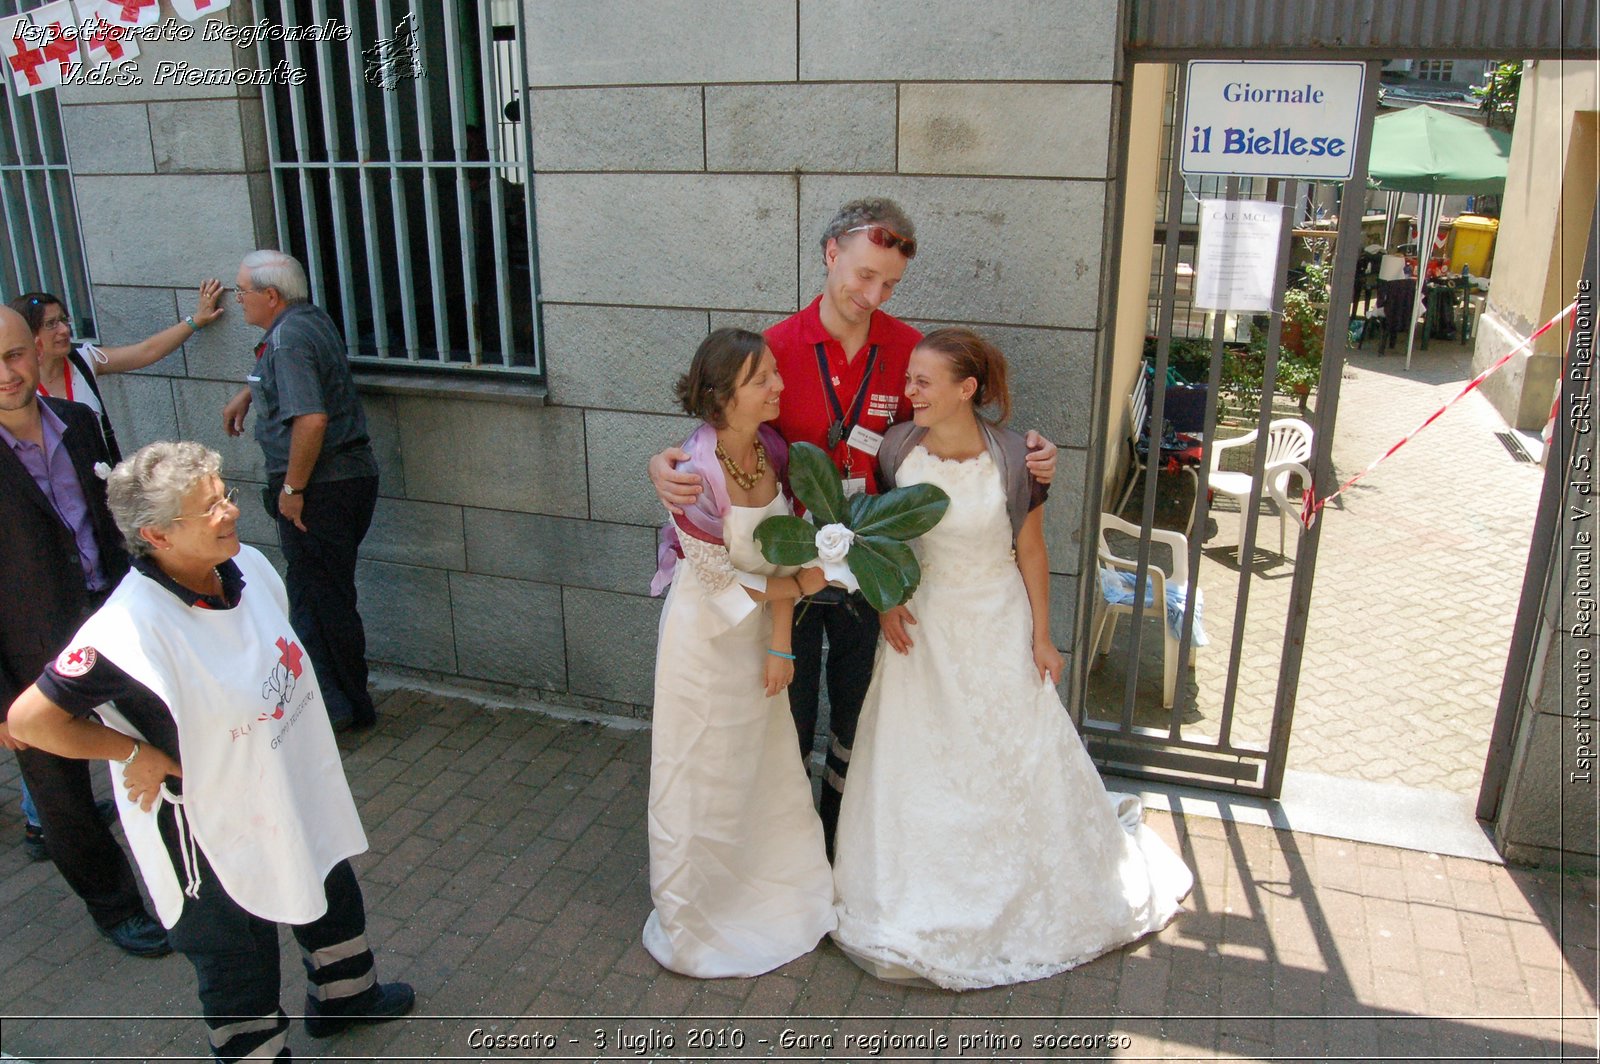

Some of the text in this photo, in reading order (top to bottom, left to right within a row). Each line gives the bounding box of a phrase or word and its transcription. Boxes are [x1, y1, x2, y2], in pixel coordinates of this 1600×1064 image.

[1222, 82, 1325, 105] Giornale
[1190, 126, 1346, 158] il Biellese
